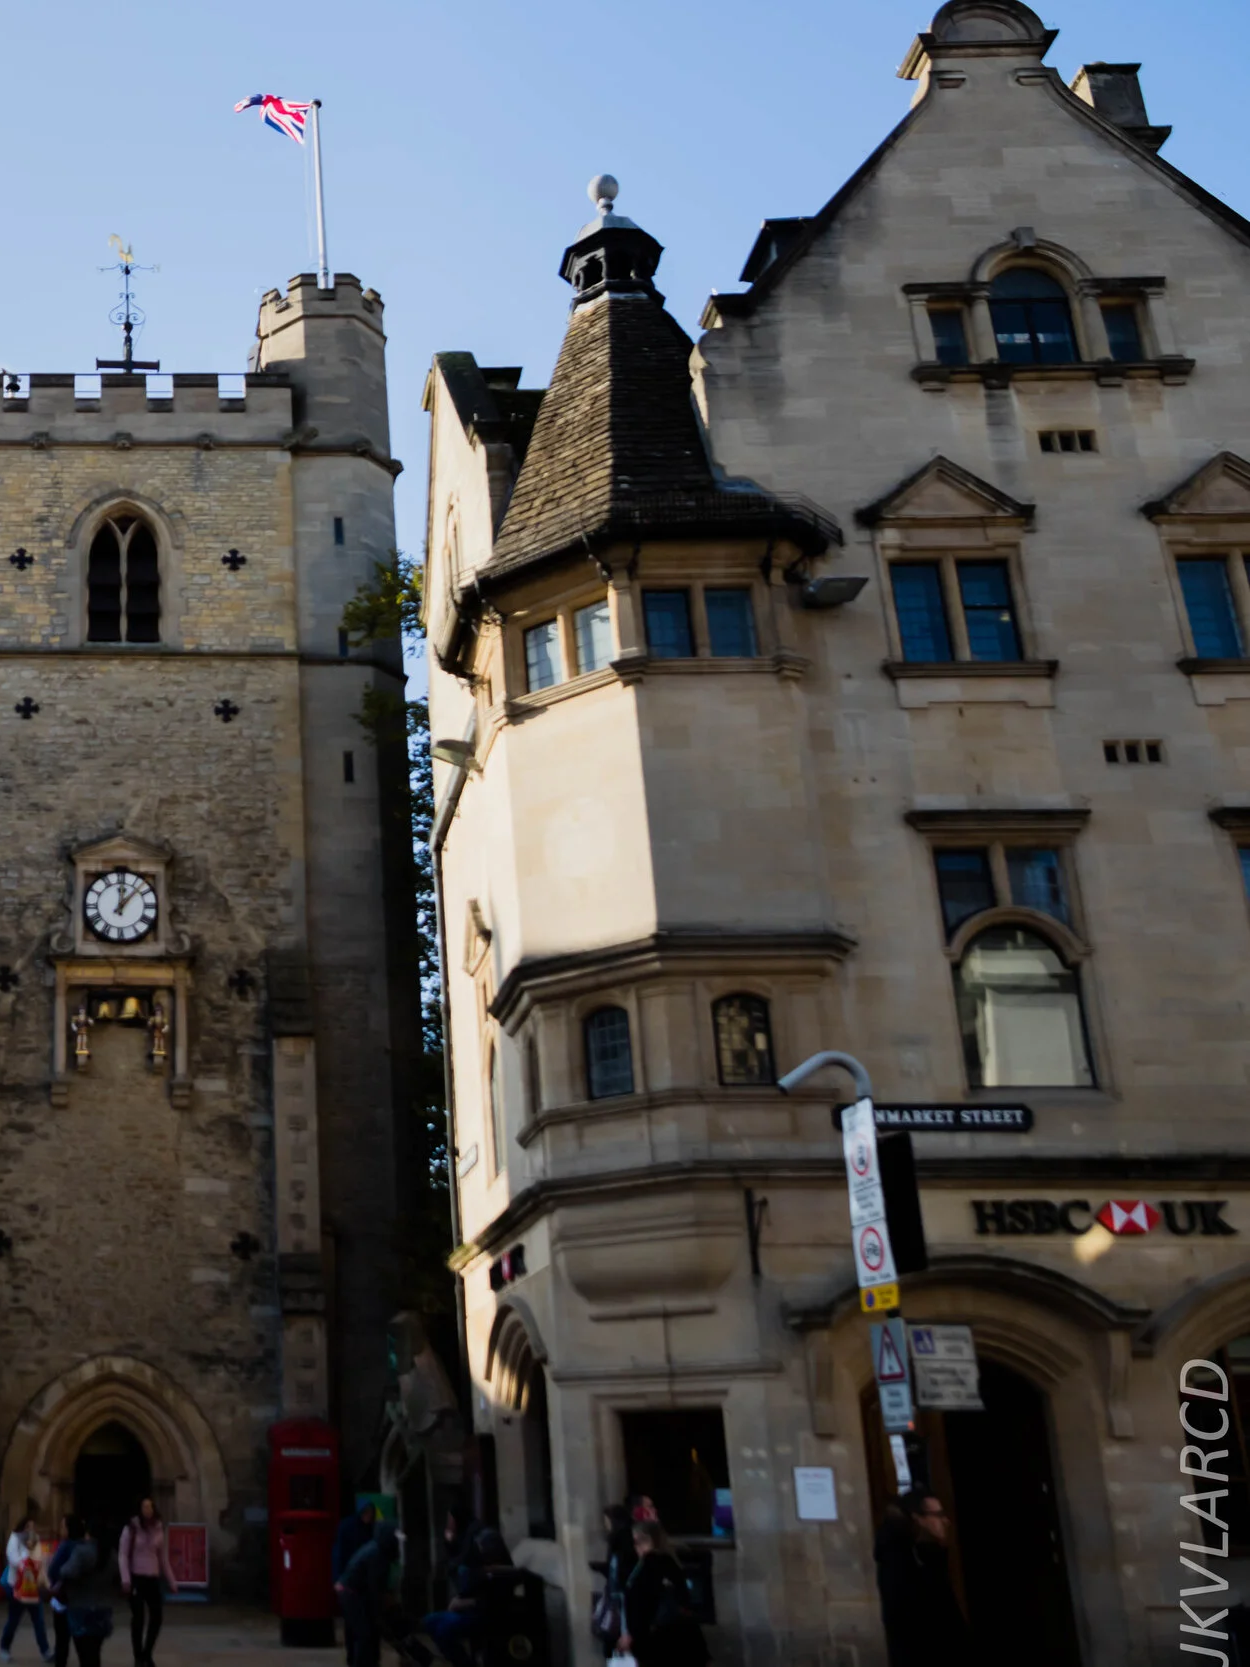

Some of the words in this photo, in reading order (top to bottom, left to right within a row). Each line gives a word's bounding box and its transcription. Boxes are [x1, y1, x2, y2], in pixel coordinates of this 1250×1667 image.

[874, 1109, 954, 1124] NMARKET
[961, 1109, 1024, 1123] STREET
[972, 1200, 1091, 1235] HSBC
[1160, 1200, 1236, 1235] UK
